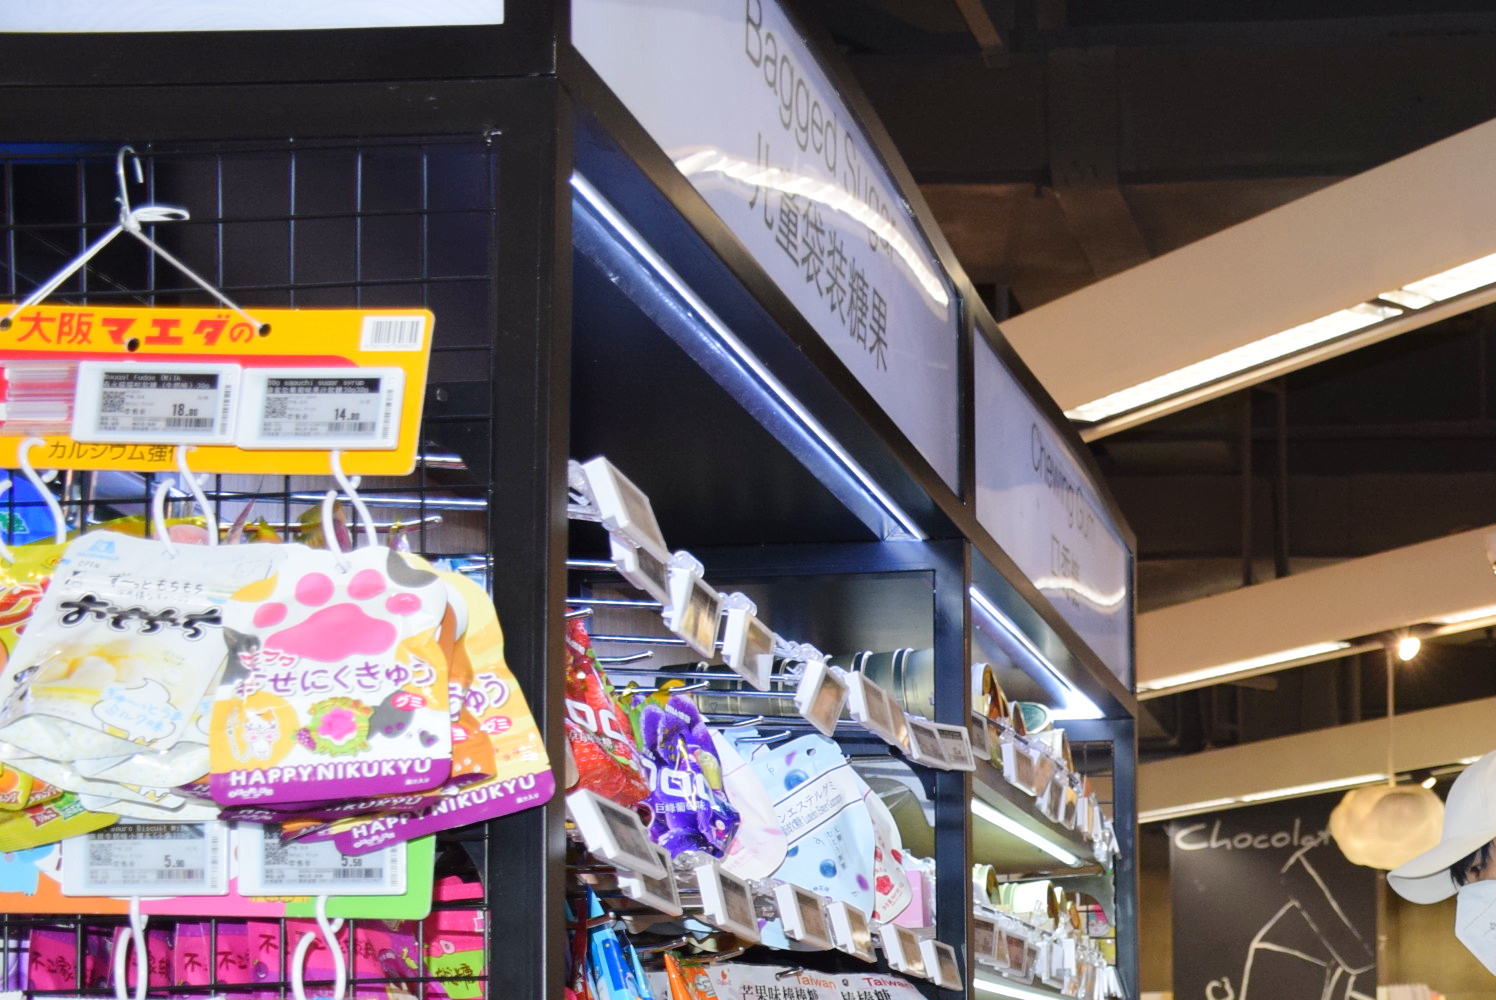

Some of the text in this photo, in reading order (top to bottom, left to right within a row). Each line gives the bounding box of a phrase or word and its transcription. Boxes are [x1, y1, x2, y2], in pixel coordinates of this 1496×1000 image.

[17, 312, 254, 346] 大阪マエダの
[795, 975, 837, 990] Taiwan
[862, 976, 915, 990] Taiwan
